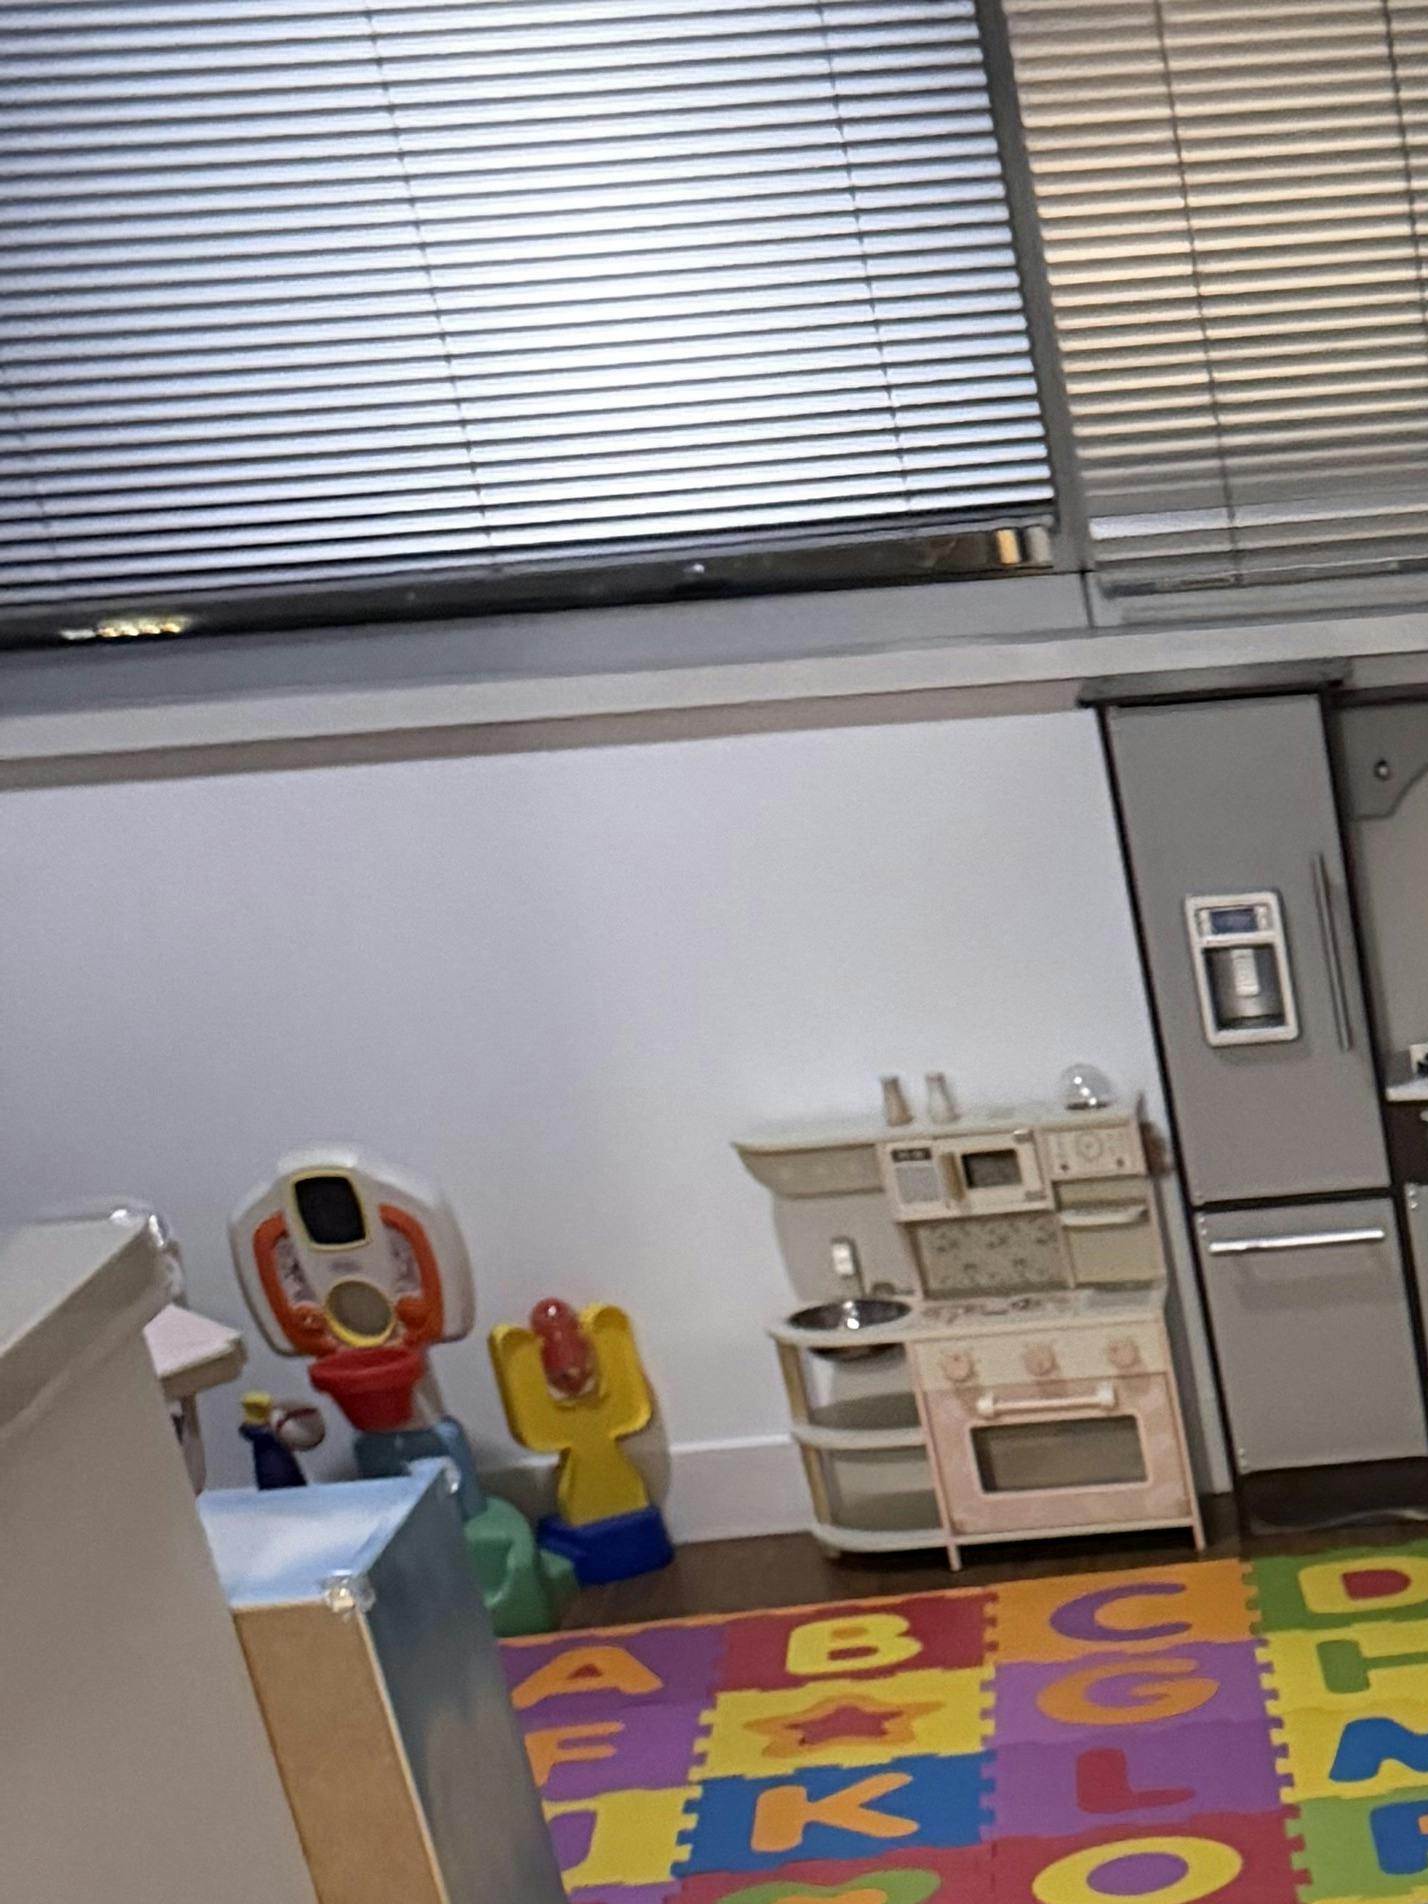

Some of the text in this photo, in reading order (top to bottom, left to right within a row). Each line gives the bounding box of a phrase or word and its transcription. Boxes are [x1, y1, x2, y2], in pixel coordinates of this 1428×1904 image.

[511, 1646, 663, 1710] A
[785, 1612, 923, 1676] B
[1048, 1582, 1193, 1642] C
[524, 1720, 625, 1788] F
[1036, 1657, 1219, 1726] G
[750, 1771, 920, 1853] K
[1075, 1746, 1196, 1815] L
